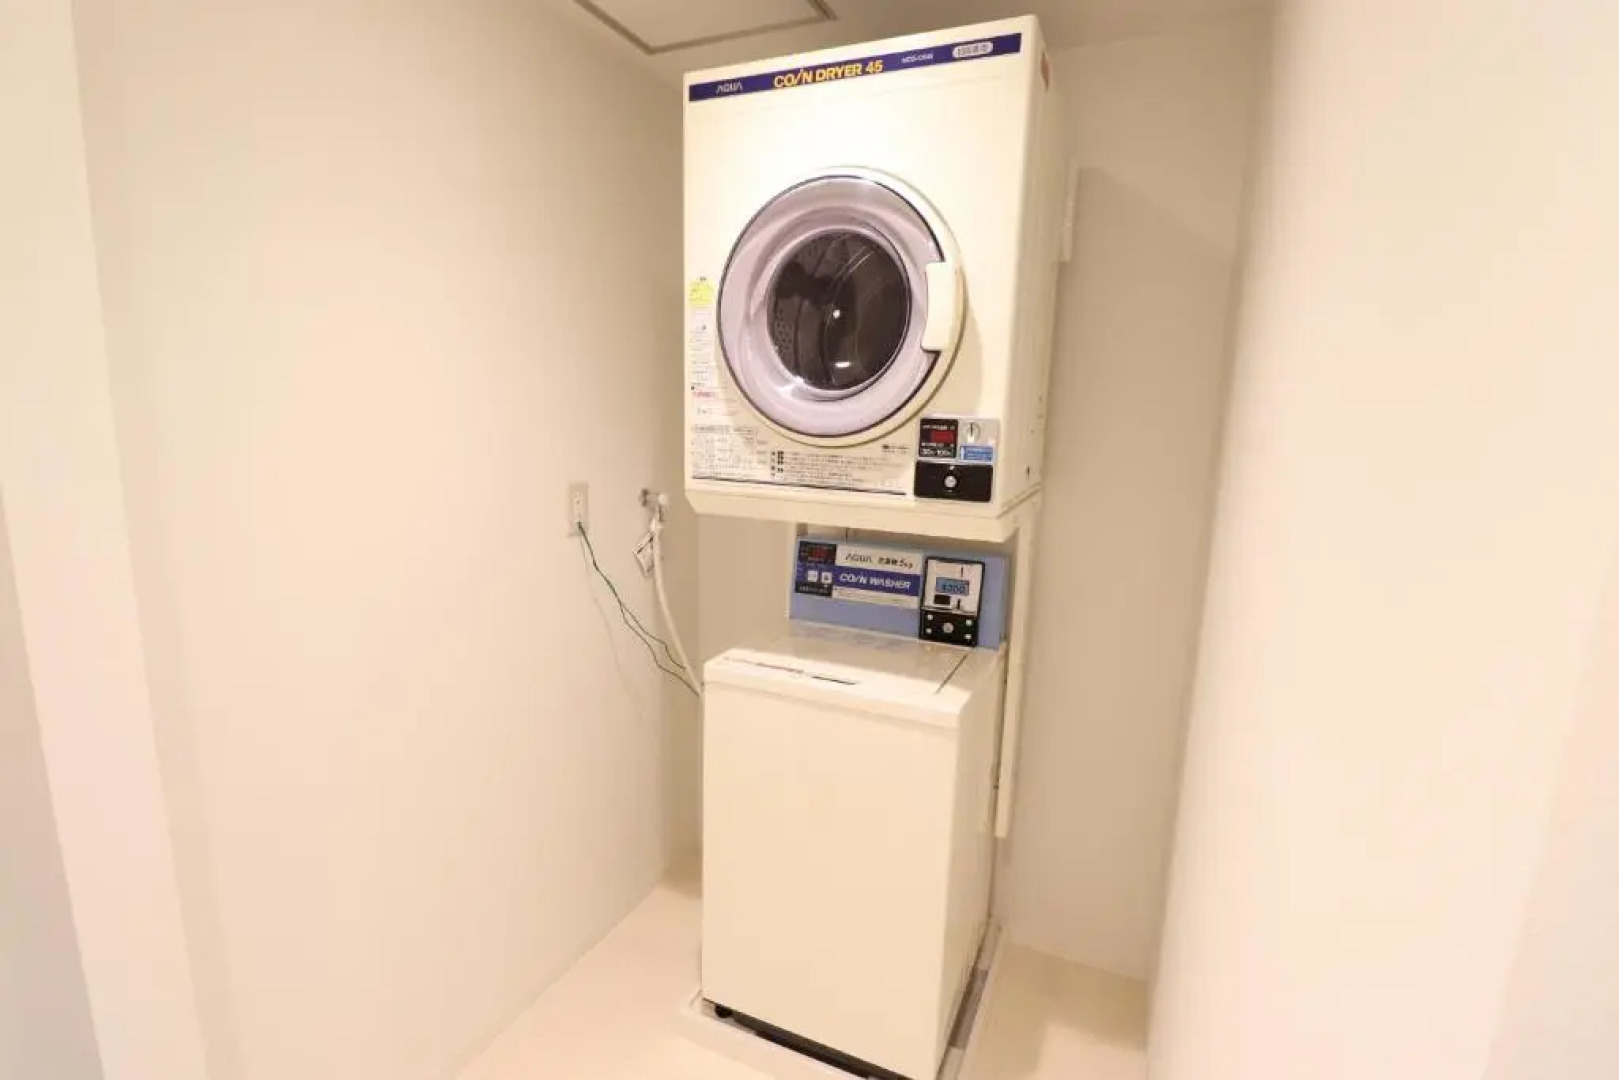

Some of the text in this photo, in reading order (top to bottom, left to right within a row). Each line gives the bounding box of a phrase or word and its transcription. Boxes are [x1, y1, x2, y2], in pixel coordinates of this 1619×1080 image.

[815, 63, 863, 82] DRYER
[865, 60, 884, 74] 45
[716, 82, 743, 94] AQUA
[869, 576, 911, 590] WASHER
